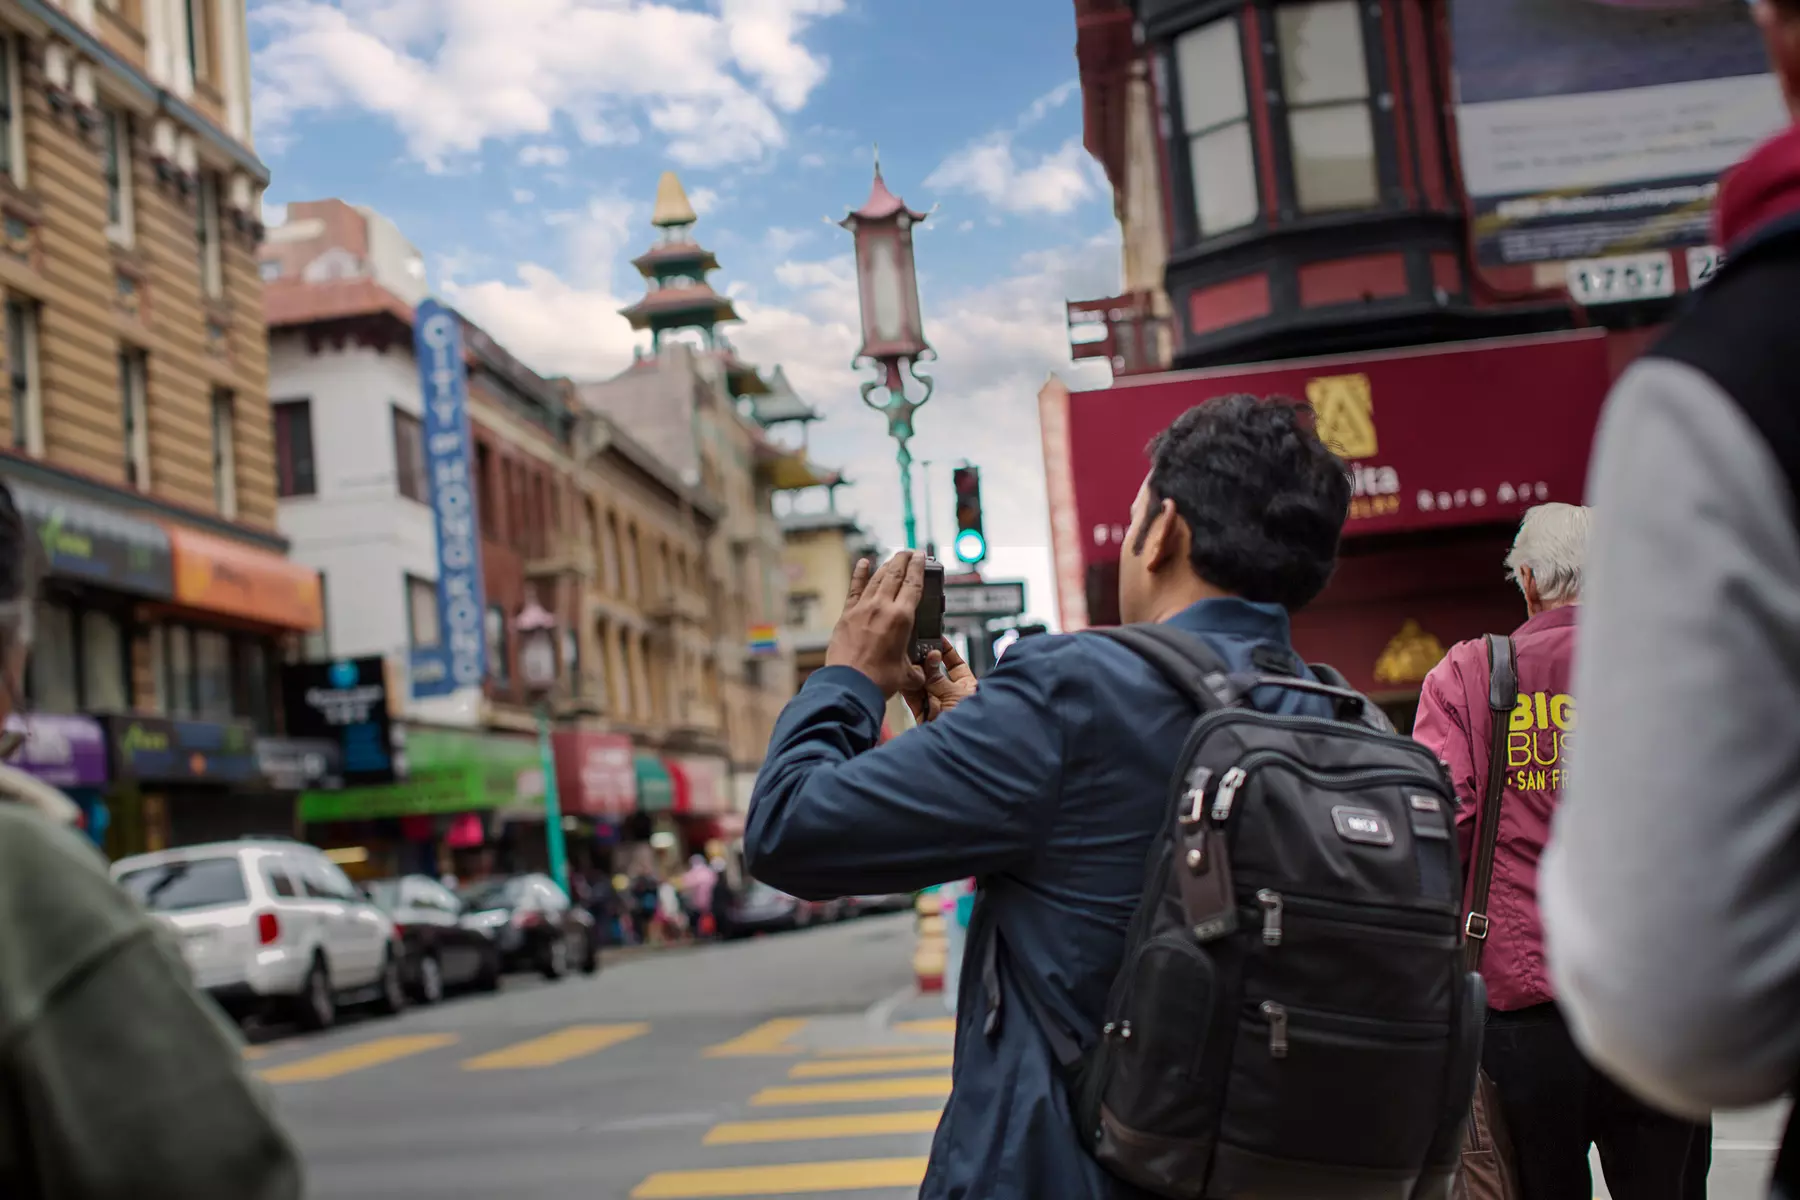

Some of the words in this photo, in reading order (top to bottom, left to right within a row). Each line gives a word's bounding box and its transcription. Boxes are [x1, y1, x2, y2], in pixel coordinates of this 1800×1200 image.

[422, 313, 458, 430] CITY
[434, 457, 473, 570] HONG
[445, 573, 483, 685] KONG
[1508, 691, 1579, 731] BIG
[1517, 770, 1546, 791] SAN
